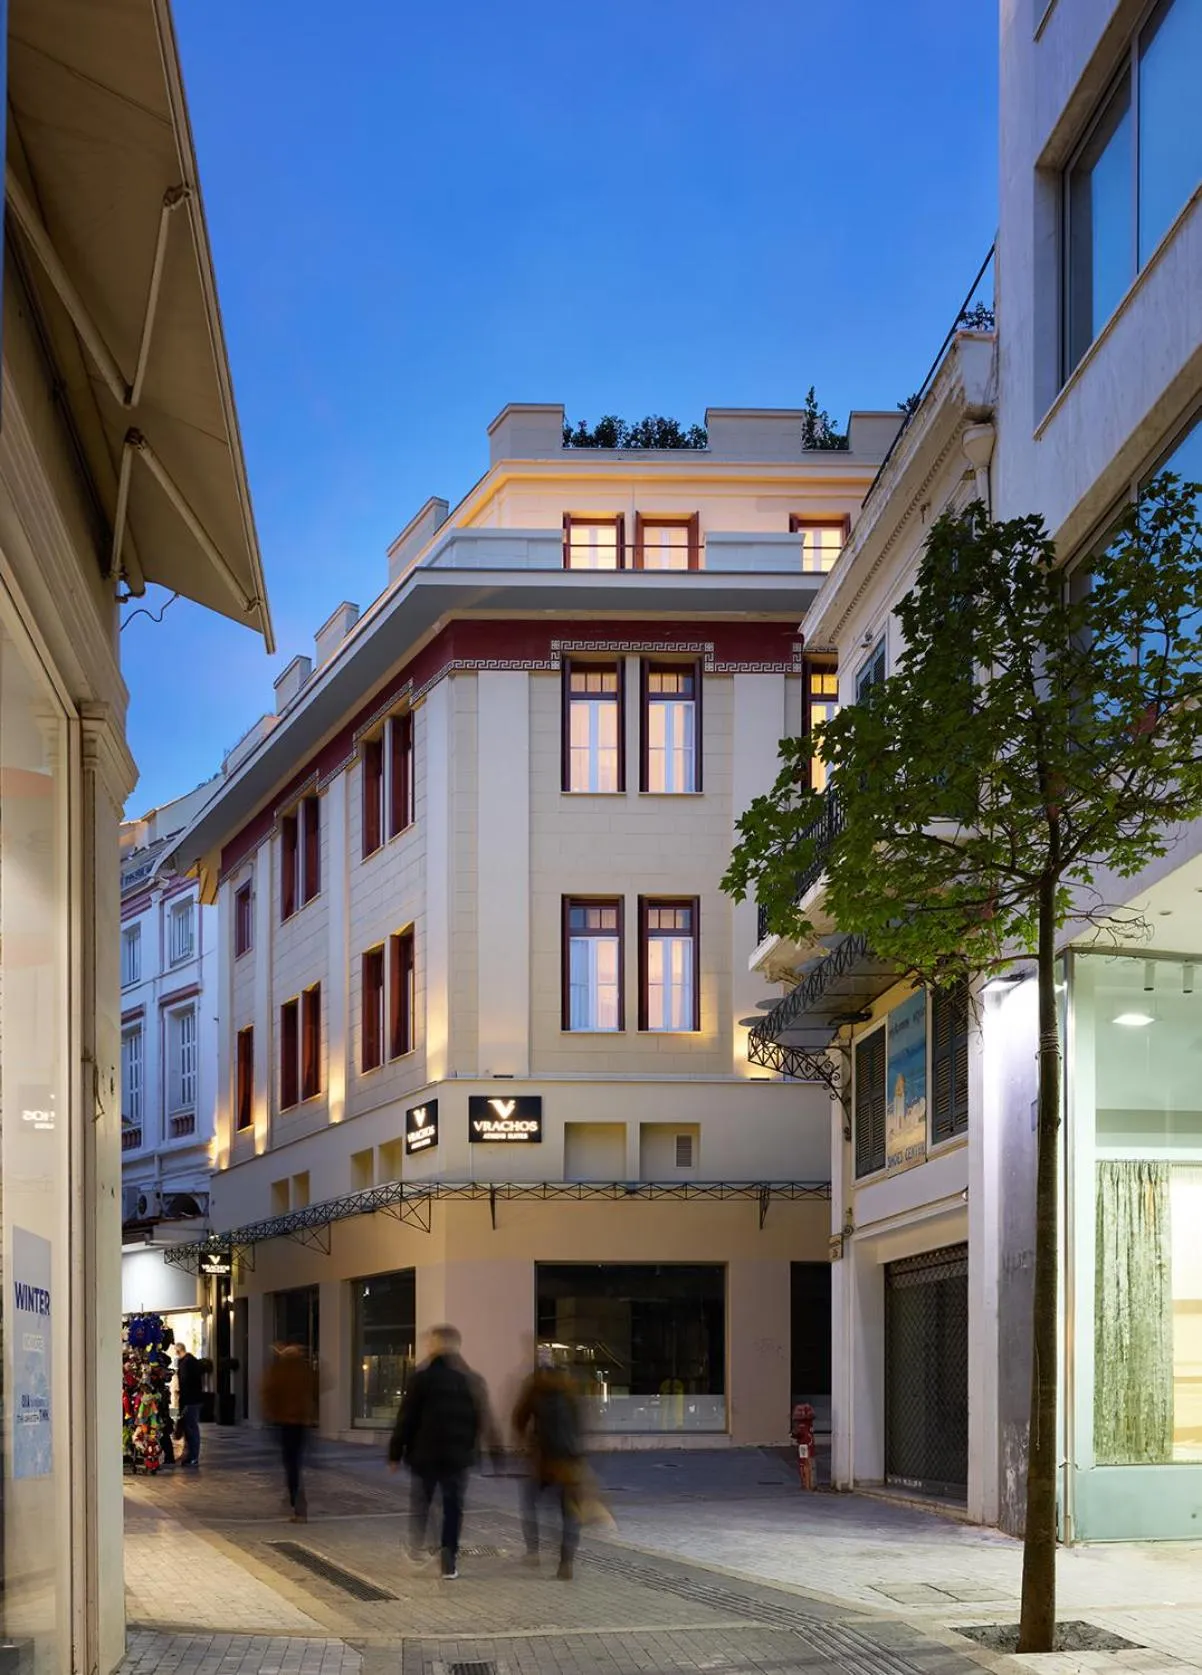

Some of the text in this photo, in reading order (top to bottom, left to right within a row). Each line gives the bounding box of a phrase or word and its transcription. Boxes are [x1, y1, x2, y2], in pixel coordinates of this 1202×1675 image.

[407, 1124, 436, 1143] VRACHOS
[473, 1120, 538, 1132] VRACHOS
[14, 1281, 50, 1316] WINTER
